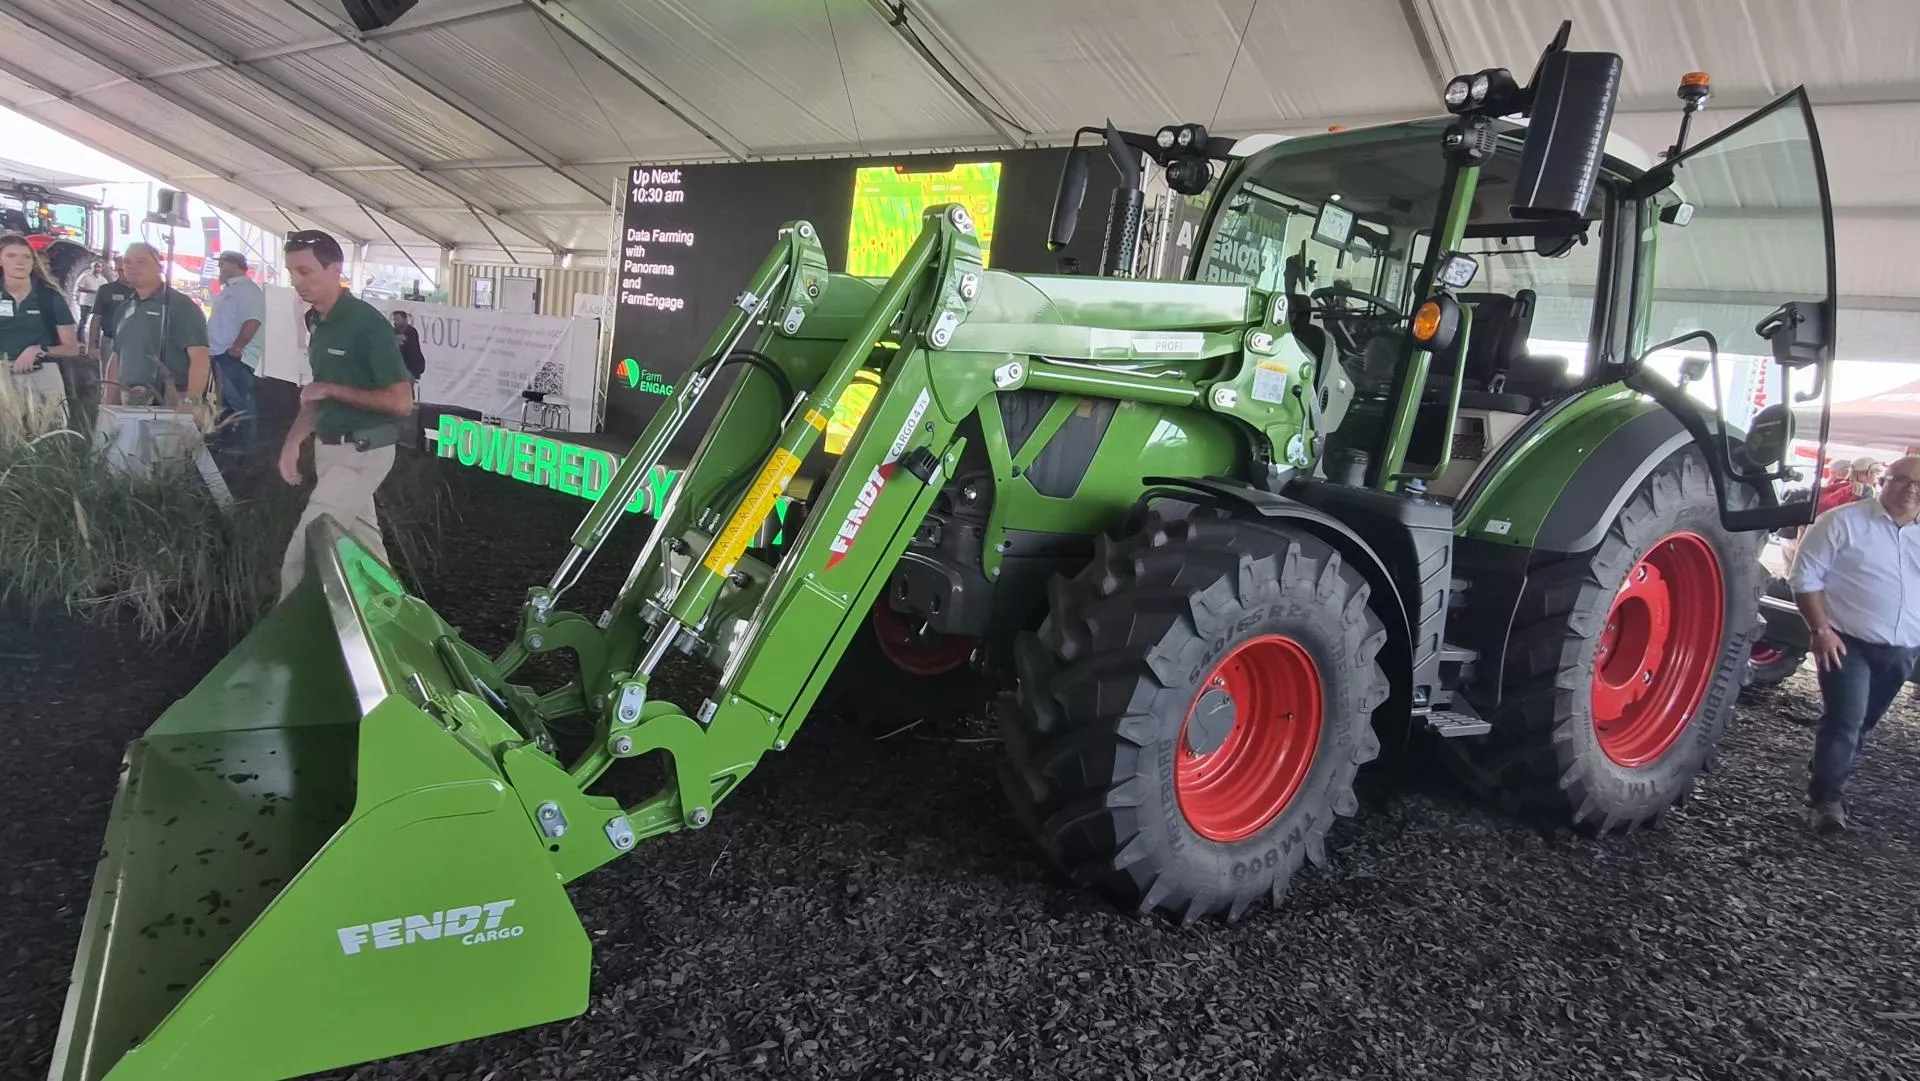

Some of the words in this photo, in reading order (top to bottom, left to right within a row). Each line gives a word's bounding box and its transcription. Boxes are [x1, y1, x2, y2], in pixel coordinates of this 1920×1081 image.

[633, 169, 650, 187] Up
[651, 168, 682, 185] Next:
[632, 187, 663, 203] 10:30
[664, 189, 685, 203] am
[627, 228, 651, 242] Data
[652, 229, 694, 247] Farming
[625, 244, 645, 258] with
[624, 259, 675, 276] Panorama
[622, 276, 642, 290] and
[621, 290, 685, 312] FarmEngage
[1155, 340, 1184, 352] PROFI
[641, 369, 662, 383] Farm
[640, 381, 674, 396] ENGAG
[891, 418, 917, 458] CARGO
[437, 414, 610, 502] POWERED
[829, 464, 886, 554] FENDT
[336, 898, 517, 956] FENDT
[461, 925, 525, 946] CARGO
